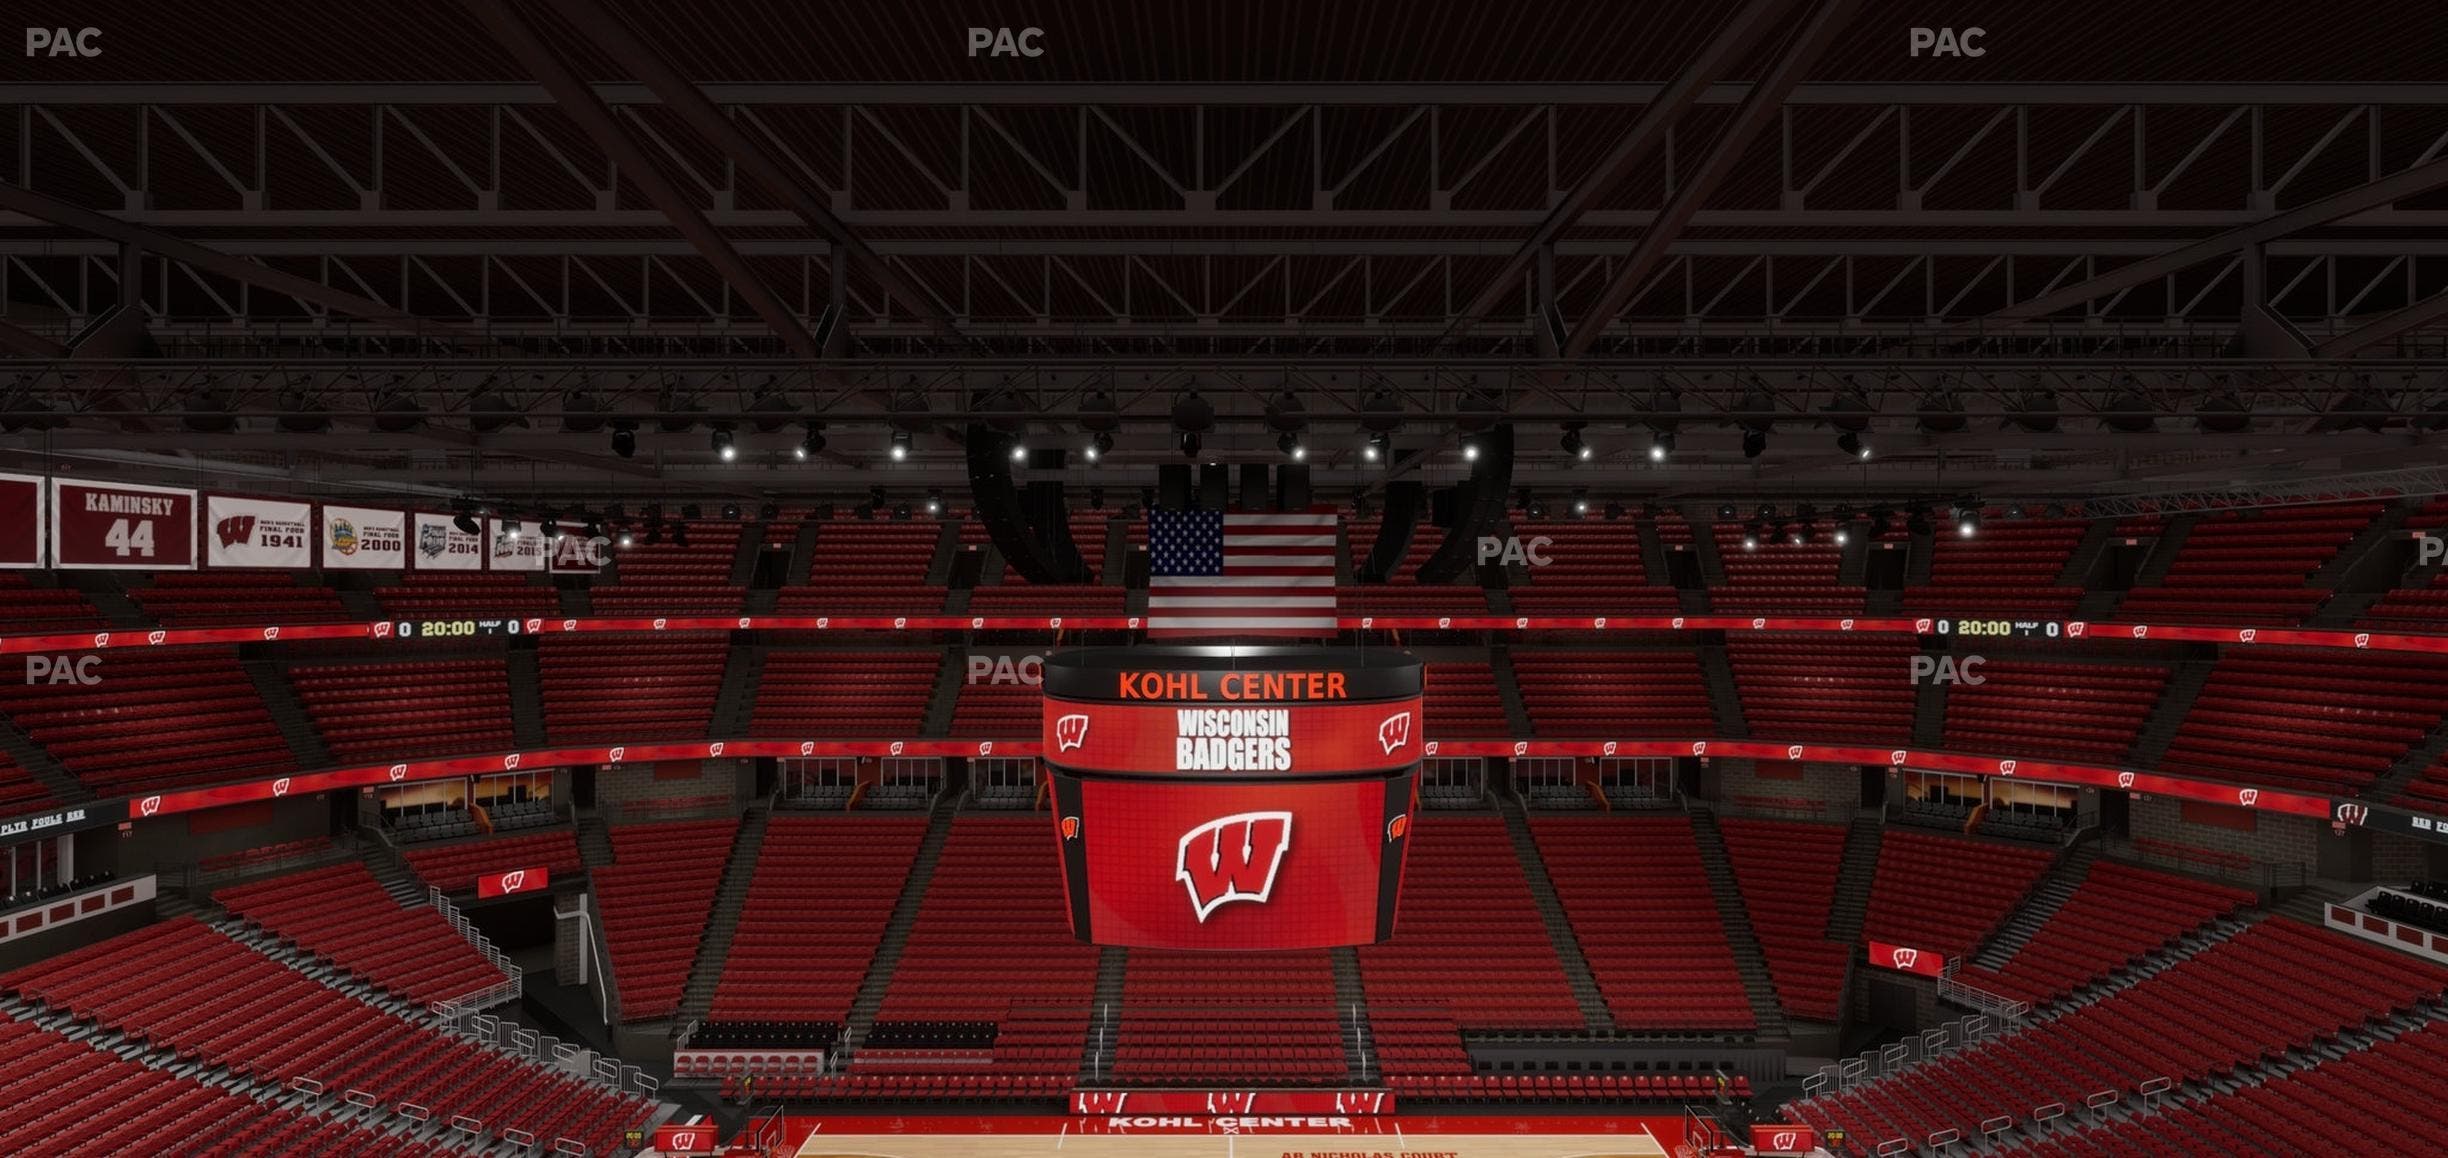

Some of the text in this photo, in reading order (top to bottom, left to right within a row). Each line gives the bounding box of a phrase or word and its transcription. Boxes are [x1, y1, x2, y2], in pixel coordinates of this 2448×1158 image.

[85, 492, 174, 516] KAMINSKY
[104, 518, 155, 557] 44
[261, 534, 303, 548] 1941
[361, 538, 401, 551] 2000
[448, 542, 480, 555] 2014
[398, 621, 412, 637] 0
[421, 620, 476, 637] 20:00
[507, 619, 520, 635] 0
[1937, 619, 1950, 635] 0
[1957, 619, 2012, 636] 20:00
[2045, 621, 2059, 637] 0
[1119, 672, 1347, 700] KOHL CENTER
[1176, 709, 1289, 737] WISCONSIN
[1175, 736, 1292, 771] BADGERS
[0, 820, 29, 836] PLYR
[31, 813, 63, 830] FOULS
[1106, 1116, 1354, 1128] KOHL CENTER
